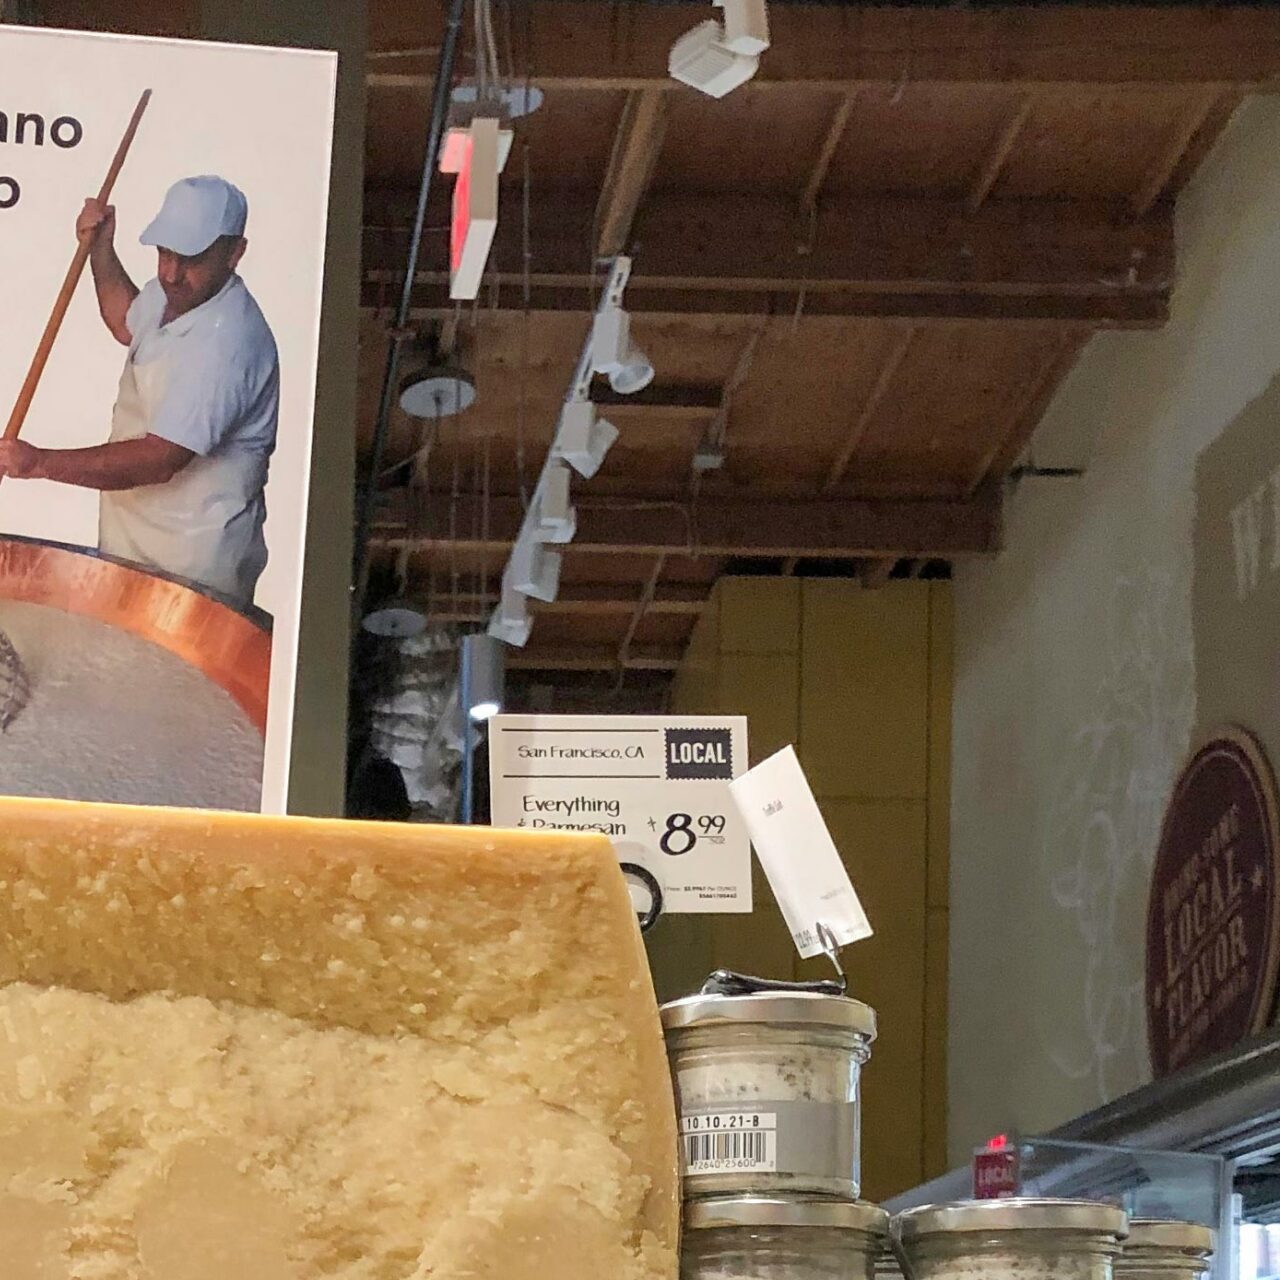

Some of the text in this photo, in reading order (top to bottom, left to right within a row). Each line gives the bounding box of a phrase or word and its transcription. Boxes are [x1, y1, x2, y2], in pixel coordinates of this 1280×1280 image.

[517, 745, 547, 758] San
[624, 746, 644, 759] CA
[670, 742, 727, 764] LOCAL
[522, 795, 620, 817] Everything
